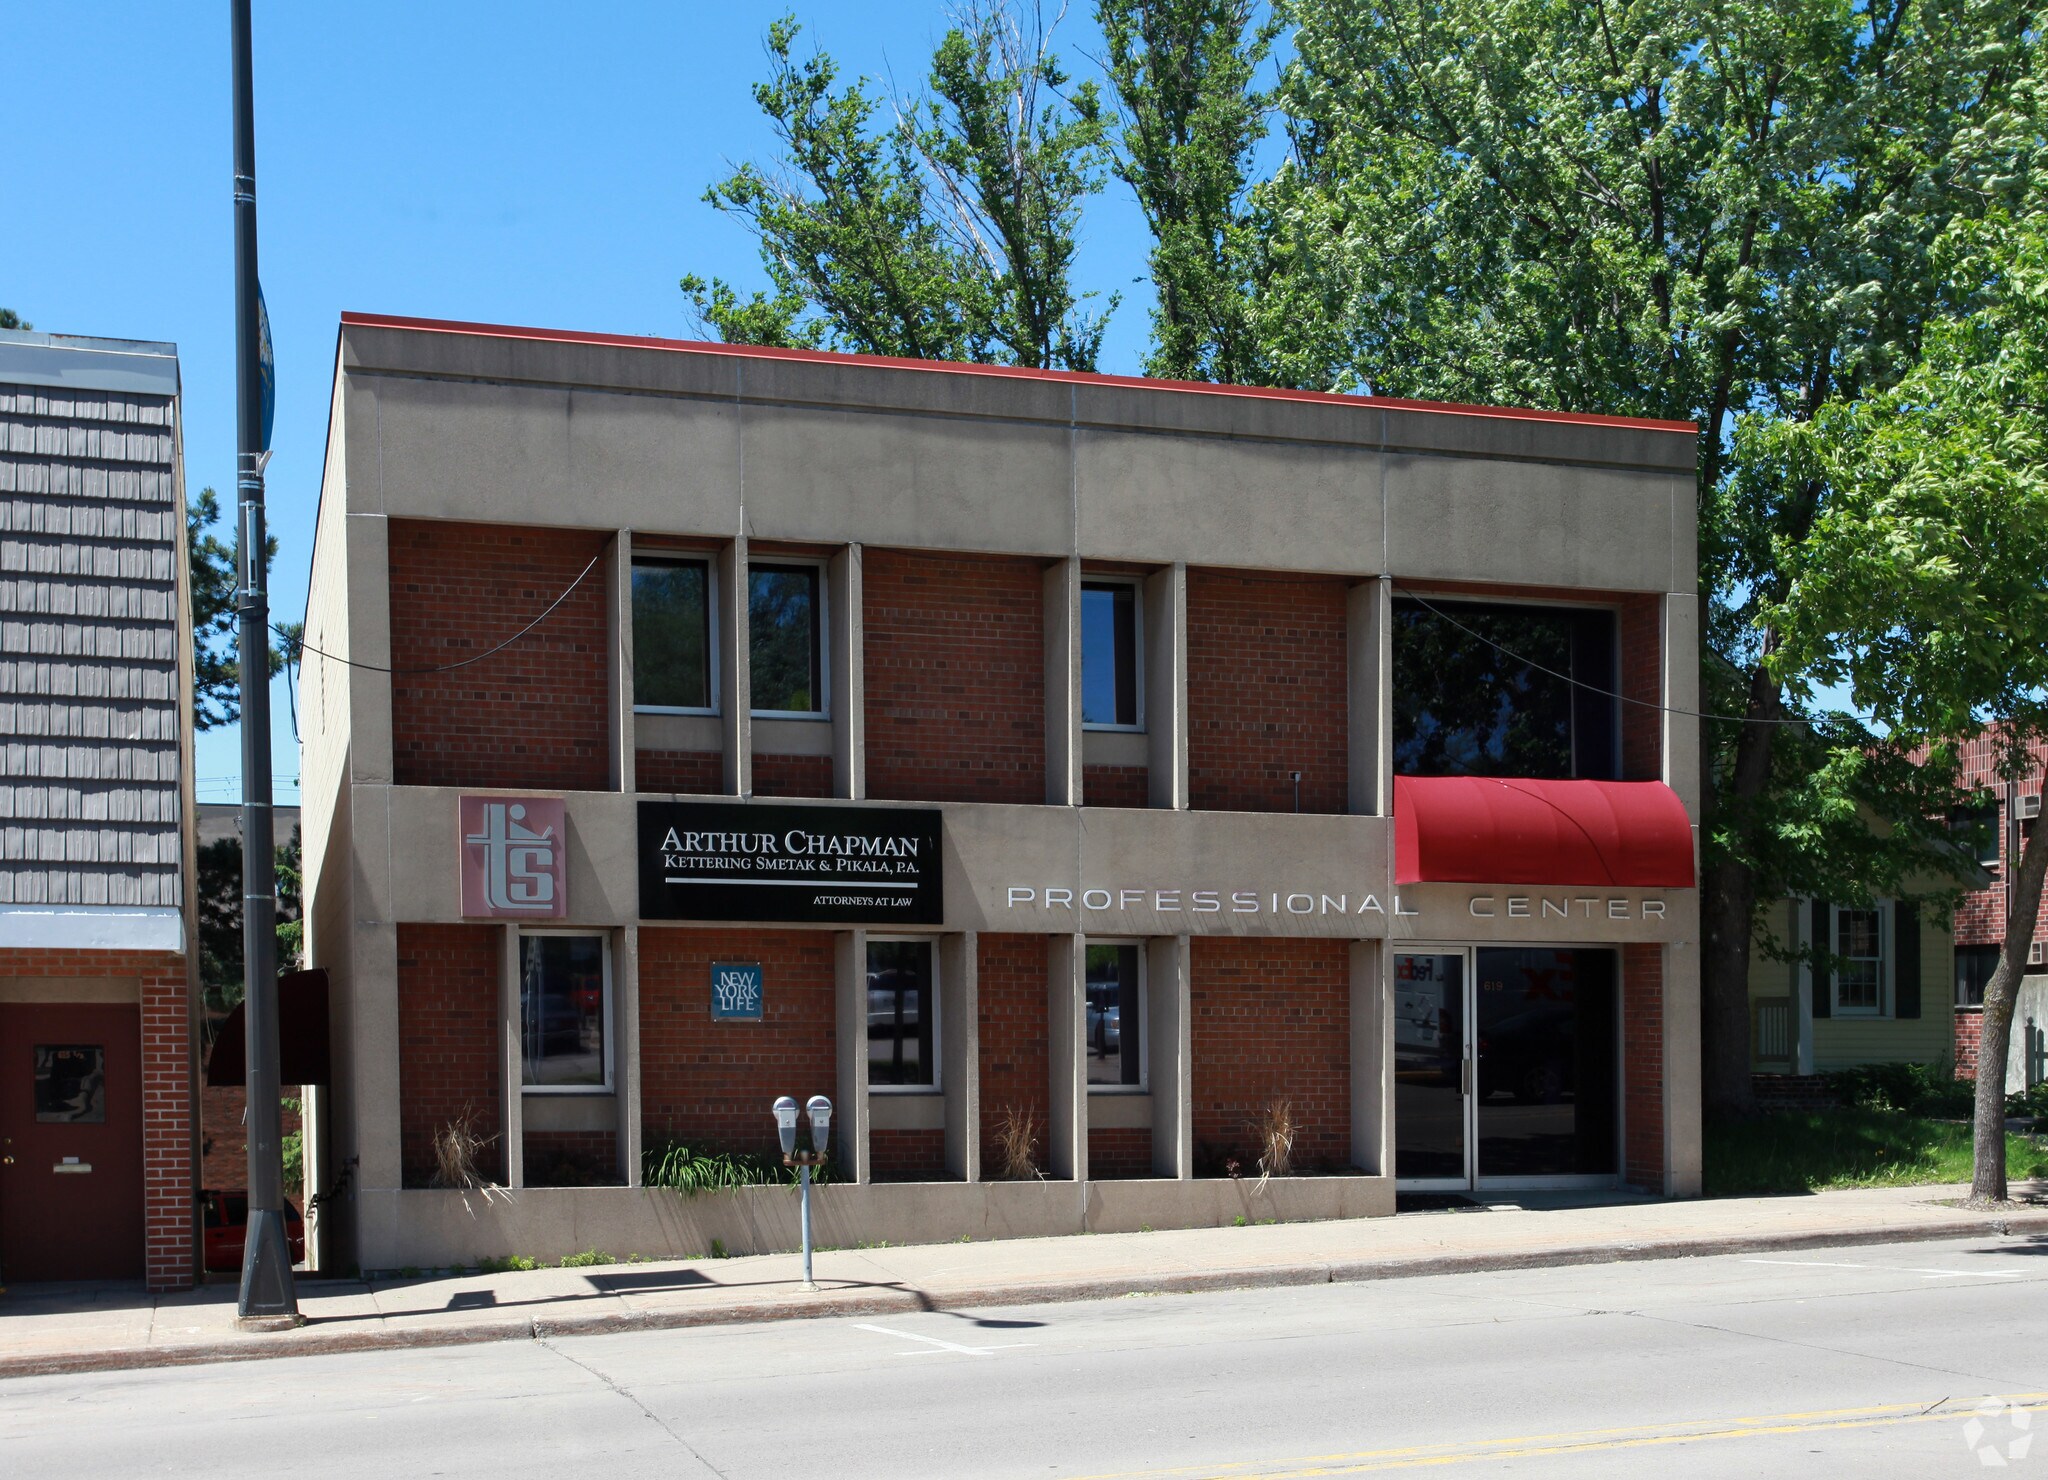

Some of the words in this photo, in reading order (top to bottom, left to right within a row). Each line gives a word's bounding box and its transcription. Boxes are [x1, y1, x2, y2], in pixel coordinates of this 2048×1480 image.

[661, 826, 778, 854] ARTHUR
[784, 830, 919, 857] CHAPMAN
[664, 854, 751, 869] KETTERING
[756, 857, 816, 871] SMETAK
[819, 860, 832, 872] &
[836, 858, 893, 875] PIKALA,
[896, 862, 920, 873] P.A.
[813, 896, 873, 906] ATTORNEYS
[875, 897, 888, 906] AT
[891, 897, 912, 907] LAW
[1008, 887, 1418, 915] PROFESSIONAL
[1469, 897, 1666, 919] CENTER
[720, 972, 755, 985] NEW
[714, 984, 758, 998] YORK
[1483, 981, 1504, 992] 619
[721, 997, 755, 1010] LIFE
